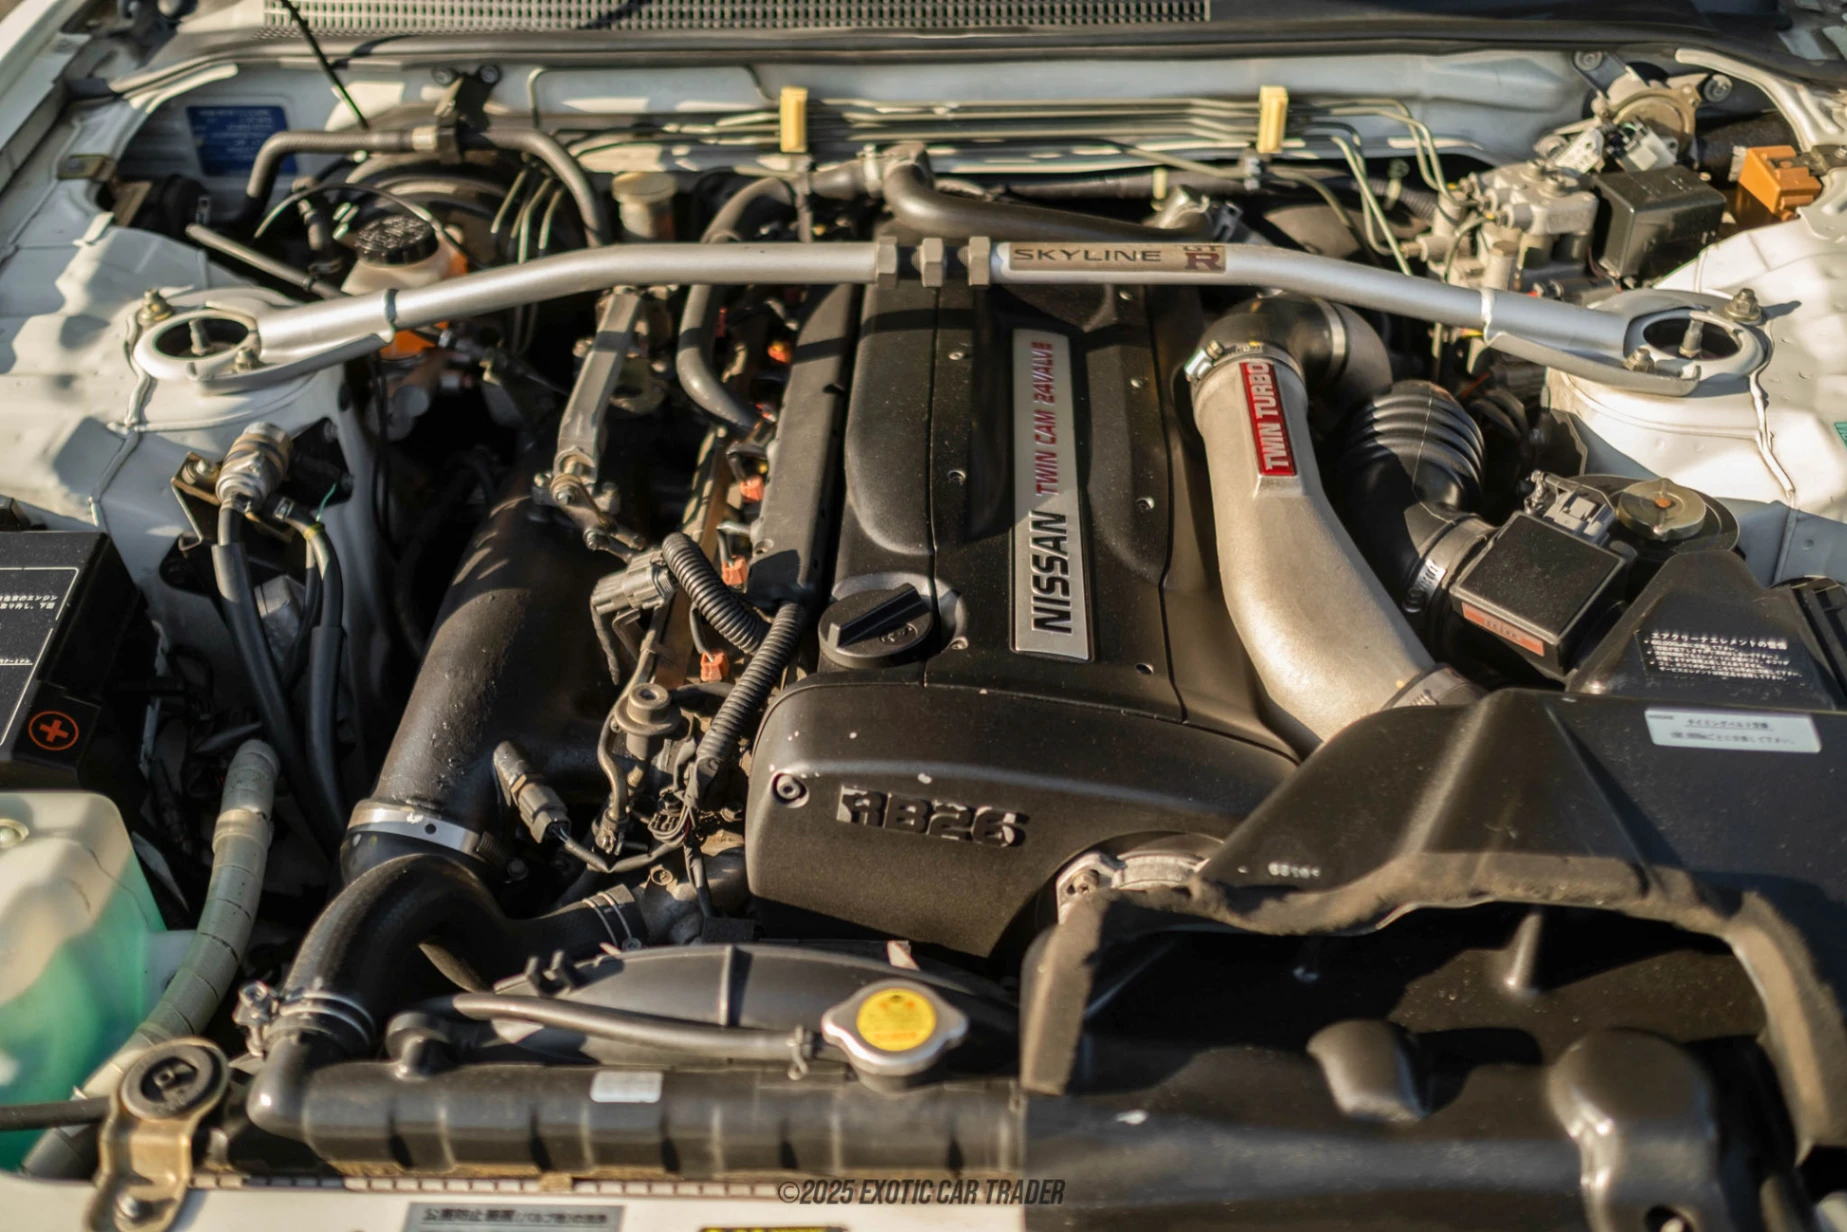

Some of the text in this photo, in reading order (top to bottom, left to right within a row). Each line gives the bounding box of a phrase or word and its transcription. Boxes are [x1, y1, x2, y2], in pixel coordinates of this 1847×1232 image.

[1013, 249, 1162, 262] SKYLINE
[1246, 362, 1290, 470] TWIN TURBO
[1029, 342, 1073, 635] NISSAN TWIN CAM 24VALVE
[836, 785, 1031, 848] RB26
